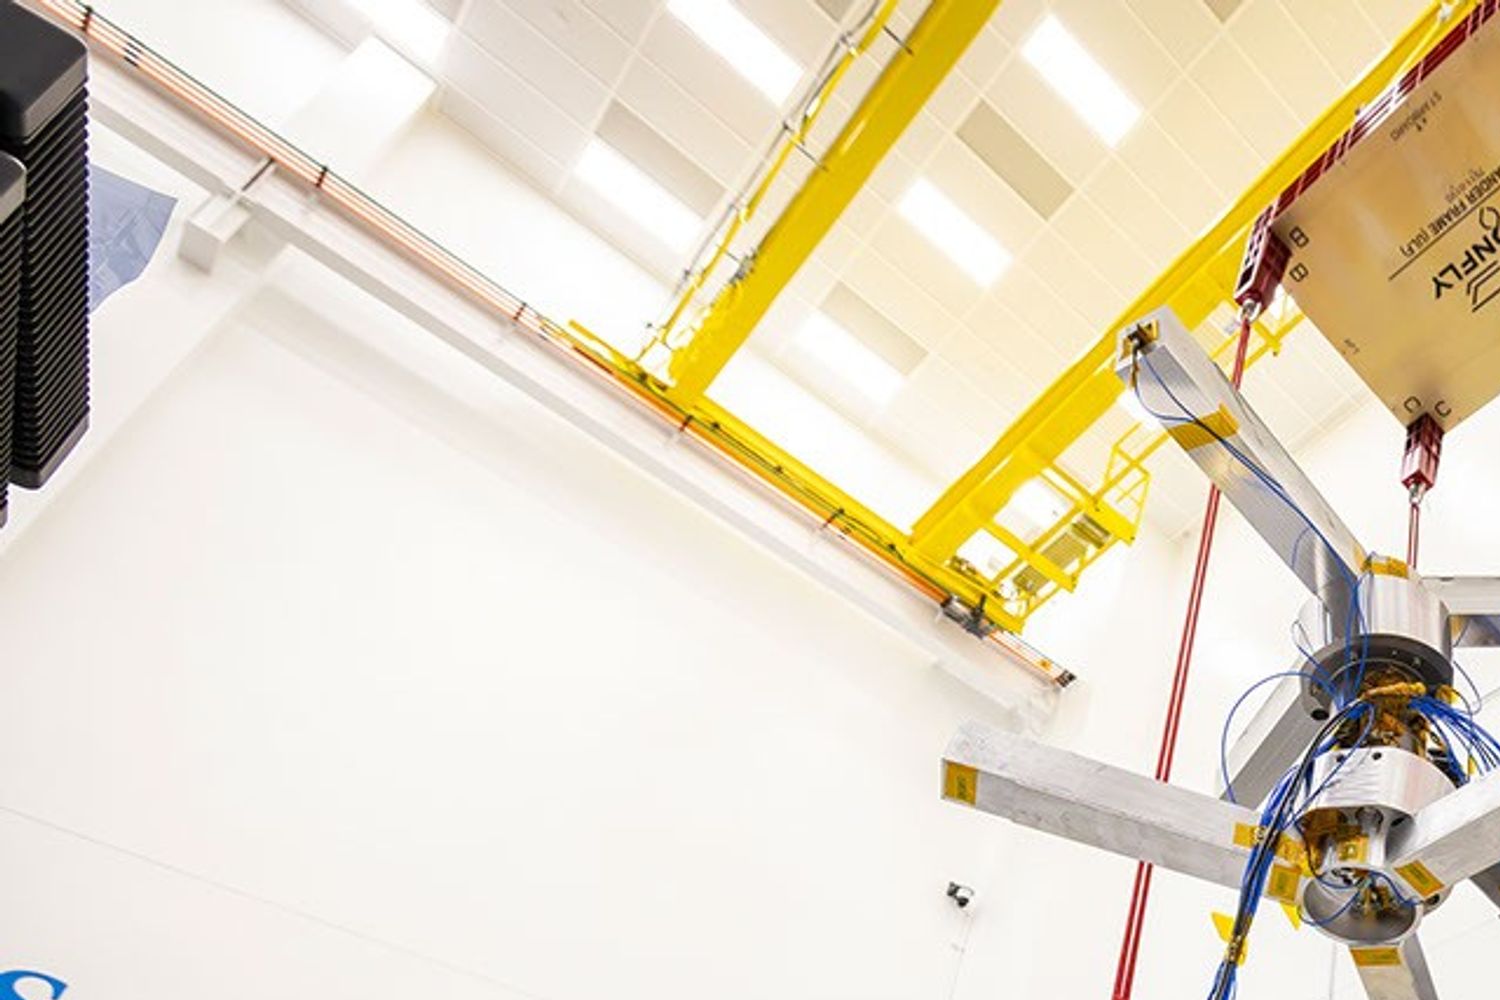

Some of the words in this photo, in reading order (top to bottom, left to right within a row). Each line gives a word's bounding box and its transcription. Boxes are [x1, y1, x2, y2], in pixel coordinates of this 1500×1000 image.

[1430, 203, 1468, 236] FRAME
[1289, 226, 1310, 248] B
[1400, 227, 1432, 258] (ULF)
[1289, 263, 1309, 282] B
[1403, 396, 1422, 414] C
[1434, 400, 1452, 417] C
